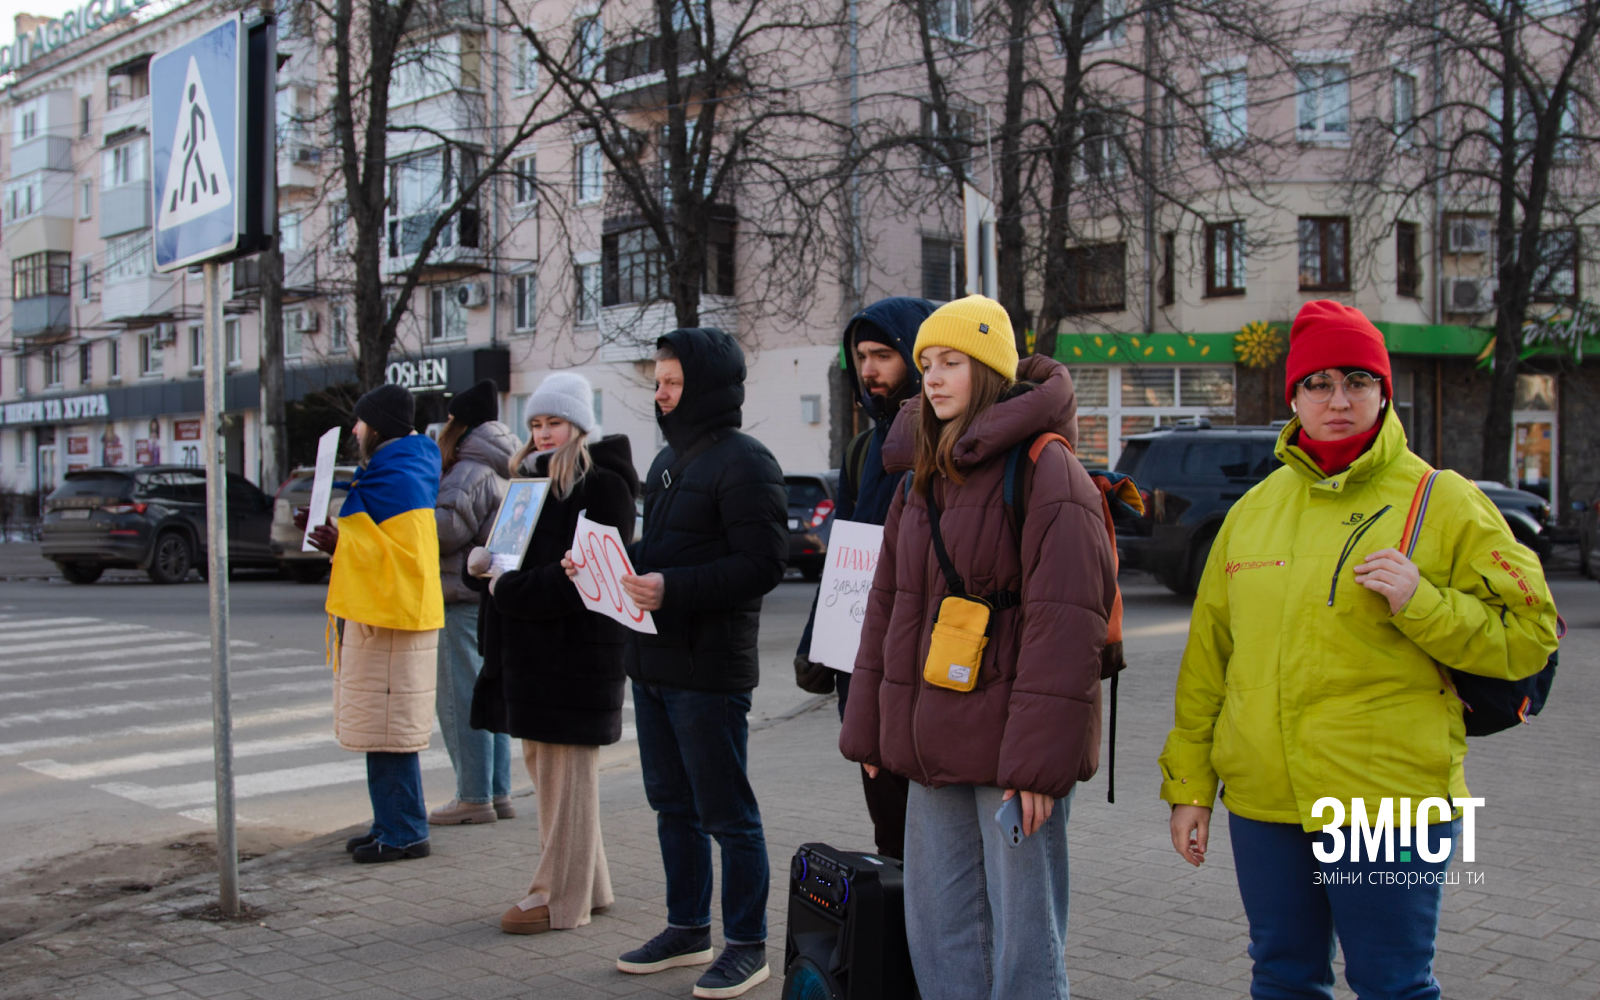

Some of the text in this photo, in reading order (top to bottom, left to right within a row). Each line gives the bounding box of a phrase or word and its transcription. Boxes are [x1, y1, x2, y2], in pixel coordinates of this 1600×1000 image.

[384, 357, 448, 388] OSHEN
[44, 399, 62, 420] ТА
[63, 394, 109, 419] ХУТРА
